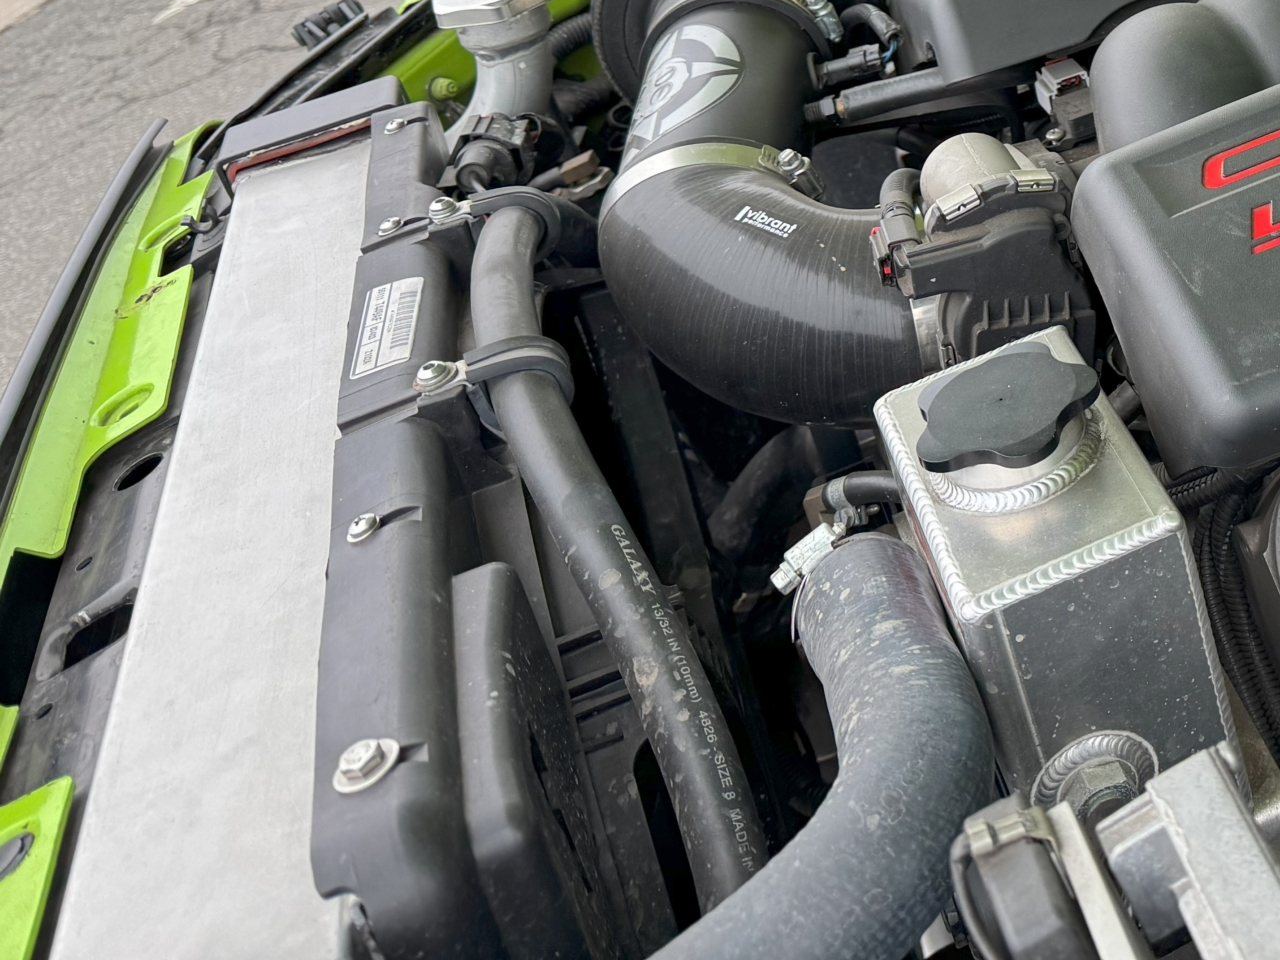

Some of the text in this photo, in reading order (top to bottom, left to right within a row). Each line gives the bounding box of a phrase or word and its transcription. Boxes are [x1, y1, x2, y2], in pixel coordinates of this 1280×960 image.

[742, 218, 789, 238] performance
[747, 209, 798, 233] vibrant
[610, 524, 657, 596] GALAXY
[651, 603, 673, 636] 13/32
[667, 634, 682, 653] IN
[672, 652, 701, 704] (10mm)
[698, 709, 718, 743] 4826
[713, 752, 734, 788] SIZE
[722, 789, 736, 801] 8
[729, 807, 751, 854] MADE
